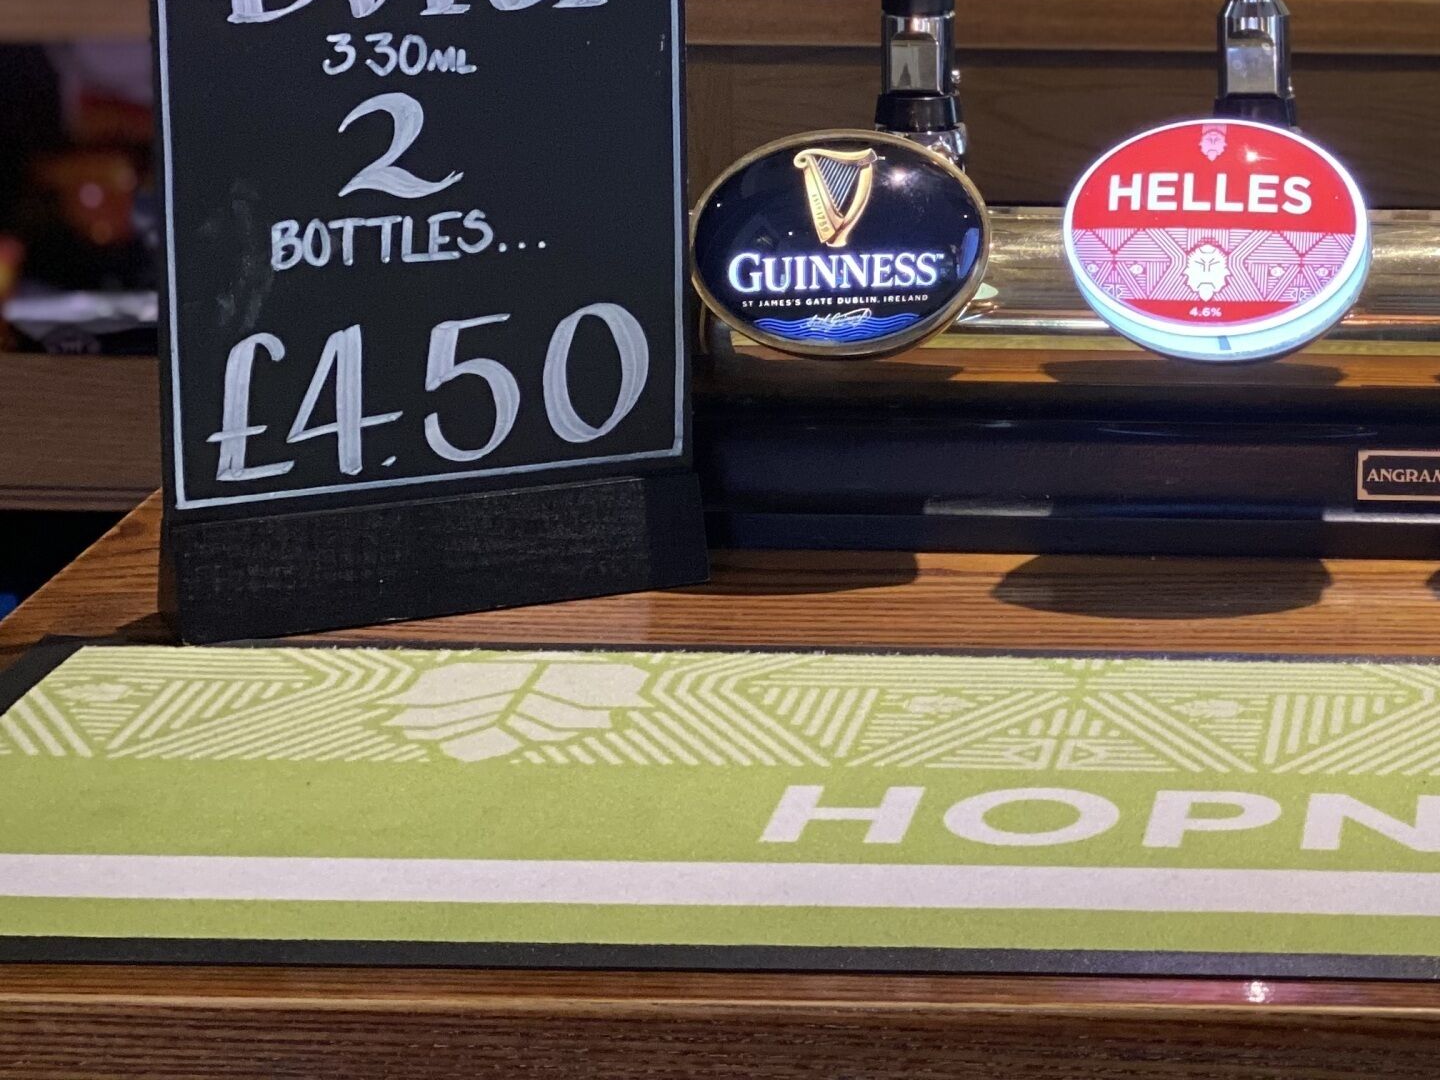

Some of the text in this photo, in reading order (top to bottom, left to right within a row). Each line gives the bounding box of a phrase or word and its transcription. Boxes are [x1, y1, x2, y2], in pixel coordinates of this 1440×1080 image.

[338, 92, 464, 199] 2
[1108, 173, 1313, 215] HELLES
[728, 252, 938, 293] GUINNESS
[805, 297, 833, 306] GATE
[883, 294, 929, 303] IRELAND
[205, 301, 650, 482] £4.50
